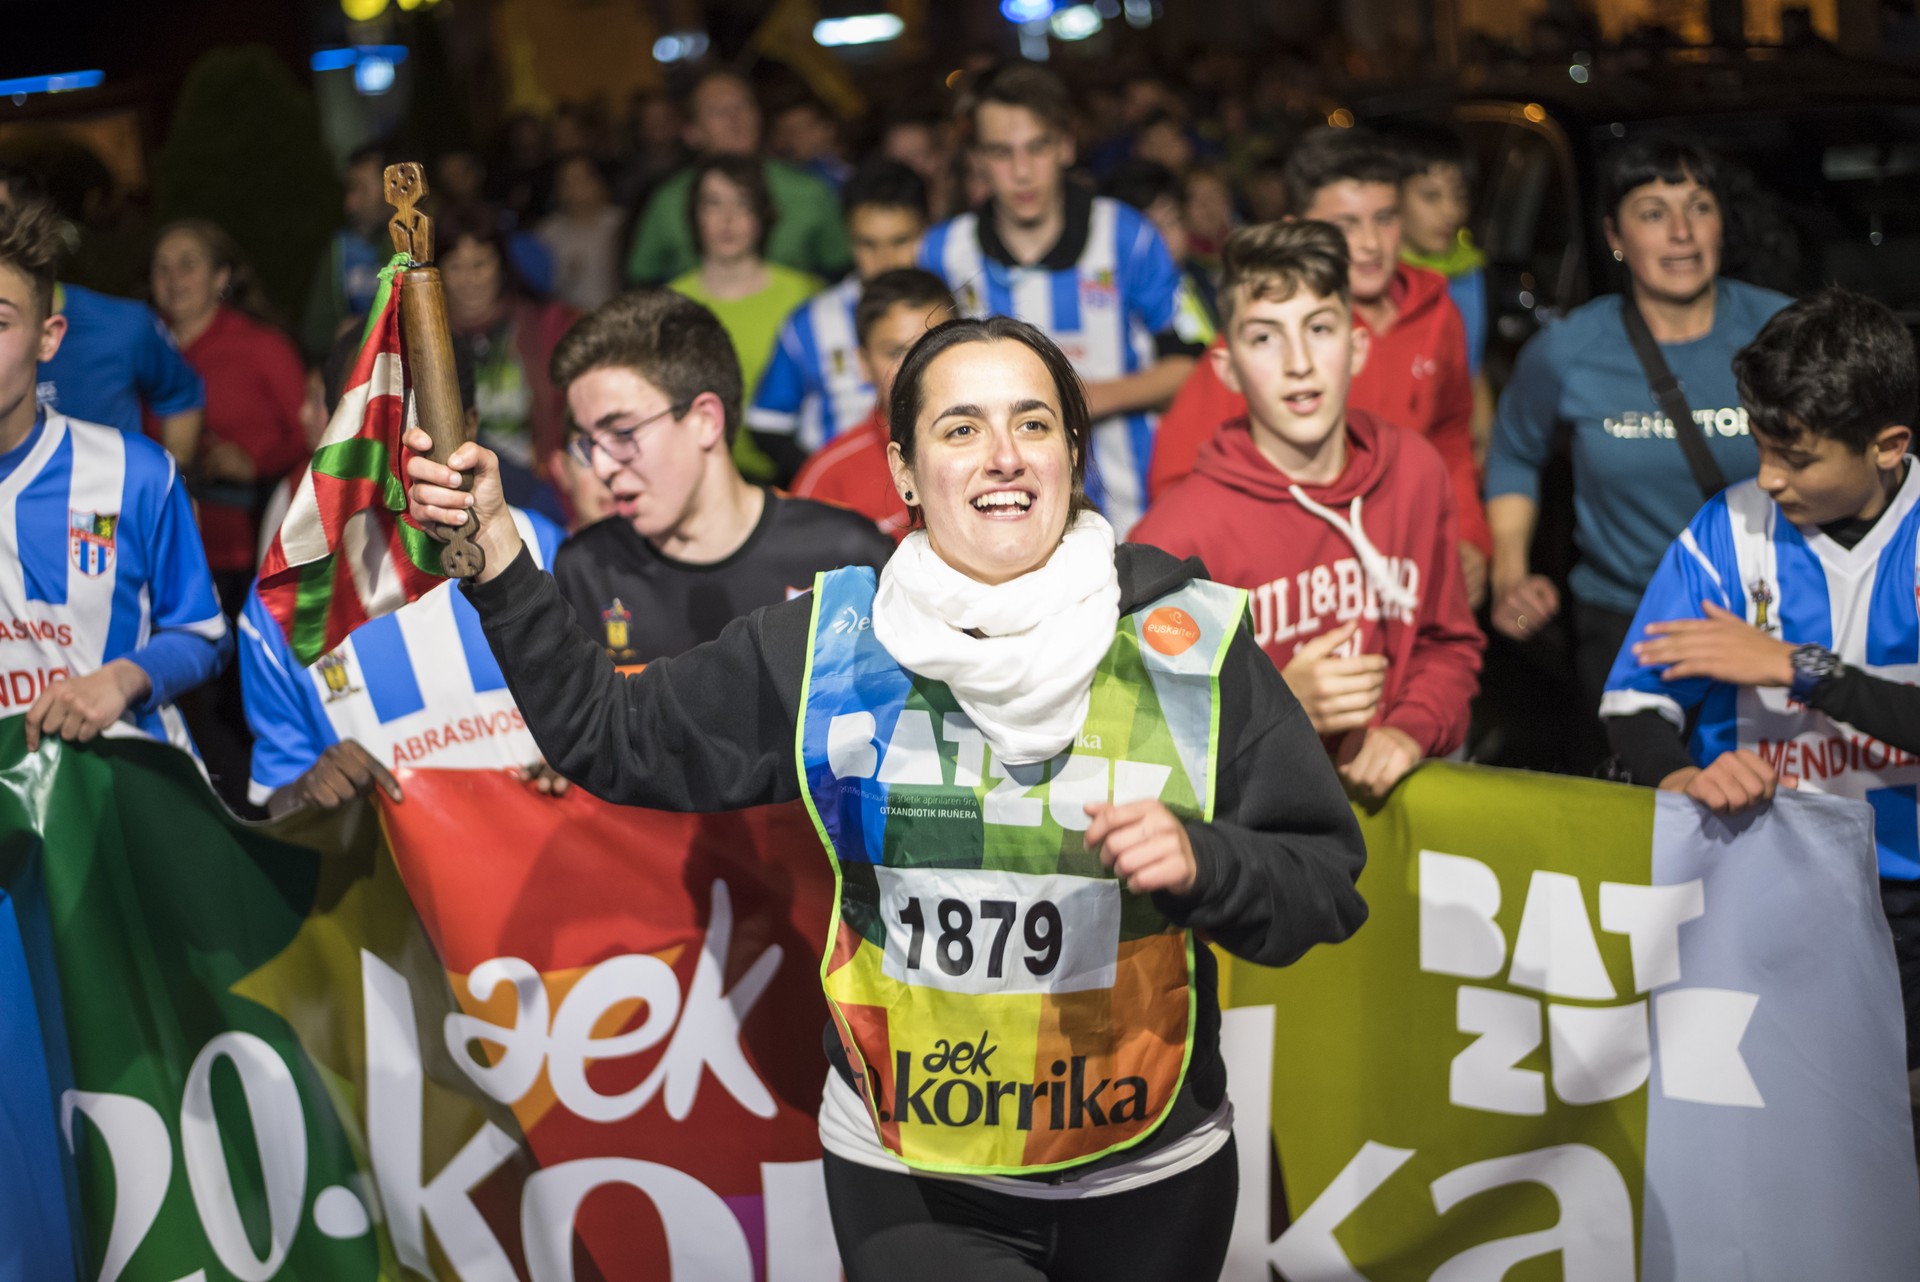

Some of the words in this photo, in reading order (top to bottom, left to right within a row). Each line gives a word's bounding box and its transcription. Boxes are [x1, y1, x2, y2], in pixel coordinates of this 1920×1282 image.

[1147, 623, 1195, 639] euskaltel
[393, 708, 526, 767] ABRASIVOS
[1758, 735, 1920, 781] MENDIOL
[879, 806, 936, 818] OTXANDIOTIK
[938, 807, 978, 820] IRUÑERA
[899, 897, 1063, 978] 1879
[1419, 849, 1705, 1000] BAT
[444, 878, 783, 1122] aek
[922, 1030, 997, 1077] aek
[1449, 985, 1766, 1116] ZUK
